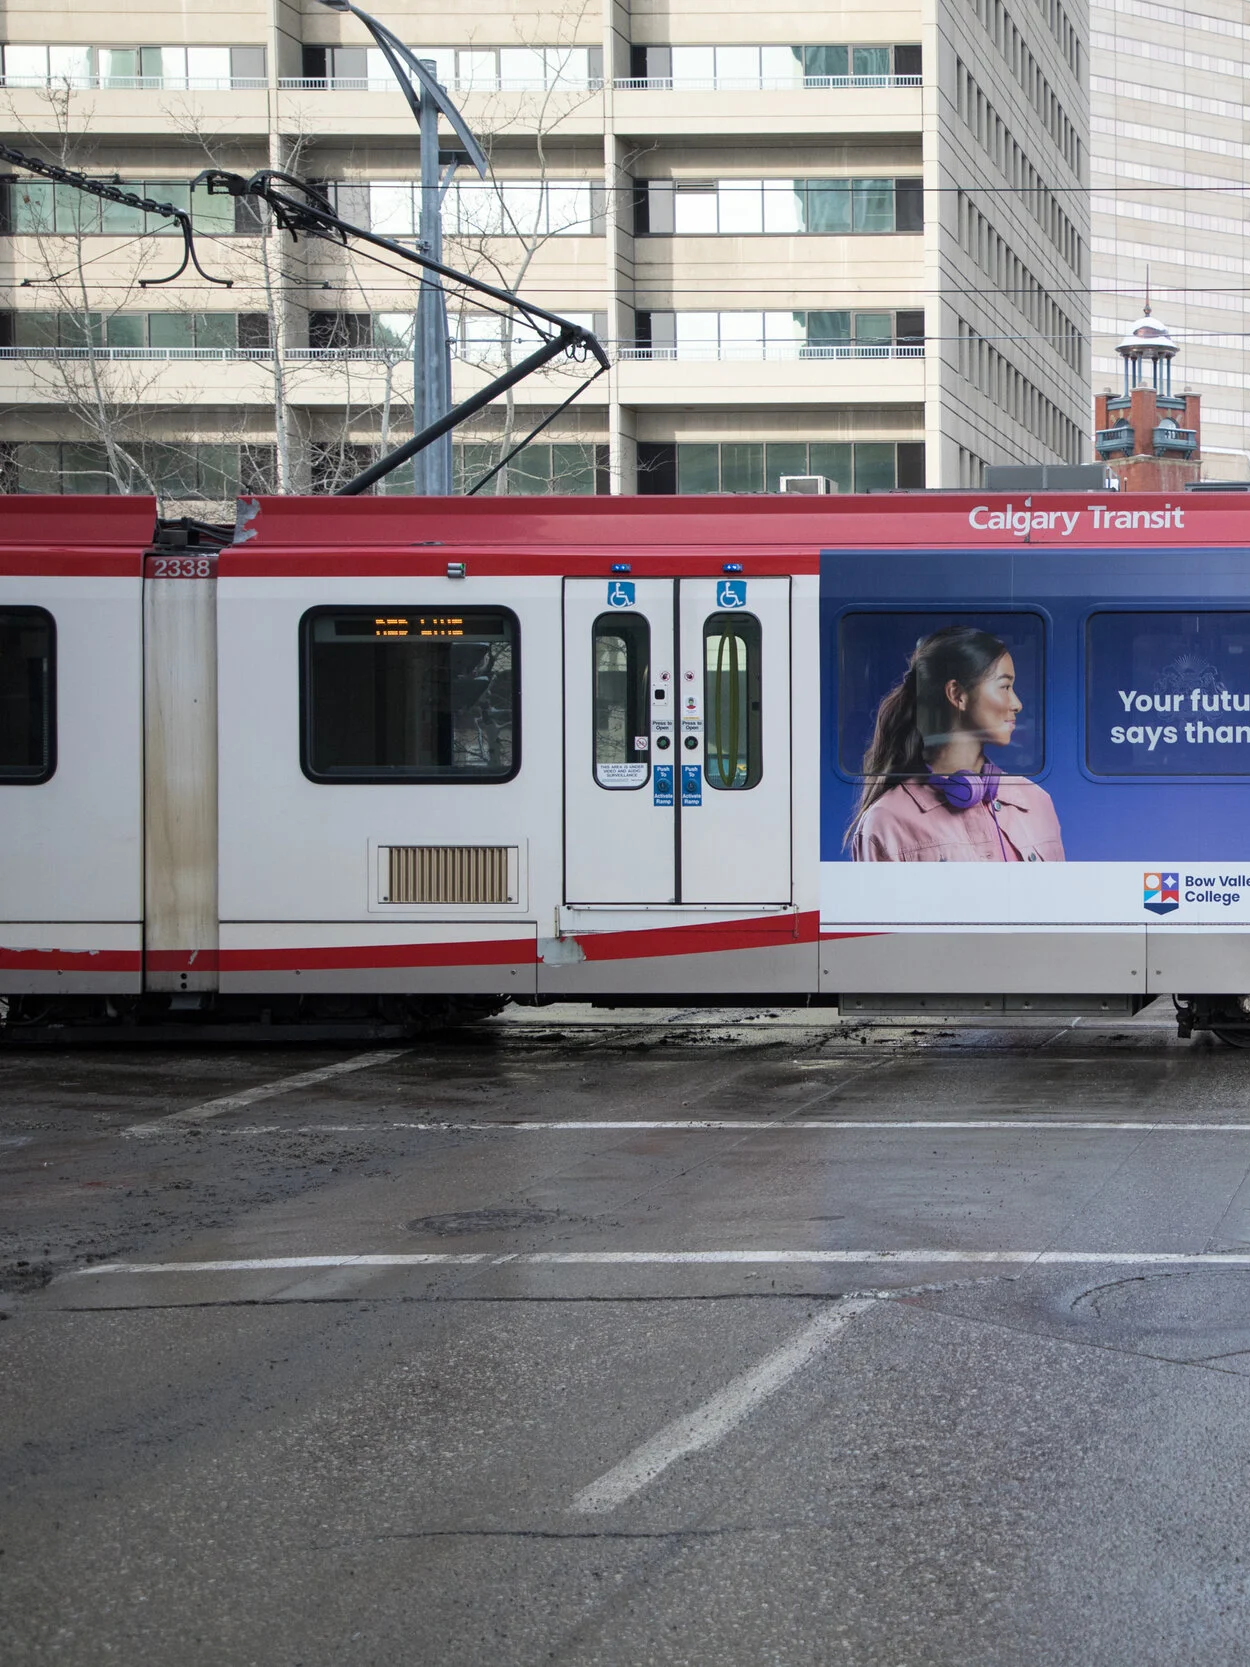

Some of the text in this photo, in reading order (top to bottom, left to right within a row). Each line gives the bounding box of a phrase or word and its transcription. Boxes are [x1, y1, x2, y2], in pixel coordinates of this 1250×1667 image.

[968, 503, 1185, 536] Calgary Transit
[154, 559, 210, 577] 2338
[1118, 690, 1184, 712] Your
[1110, 725, 1178, 751] says
[1185, 875, 1215, 887] Bow
[1185, 890, 1241, 906] College
